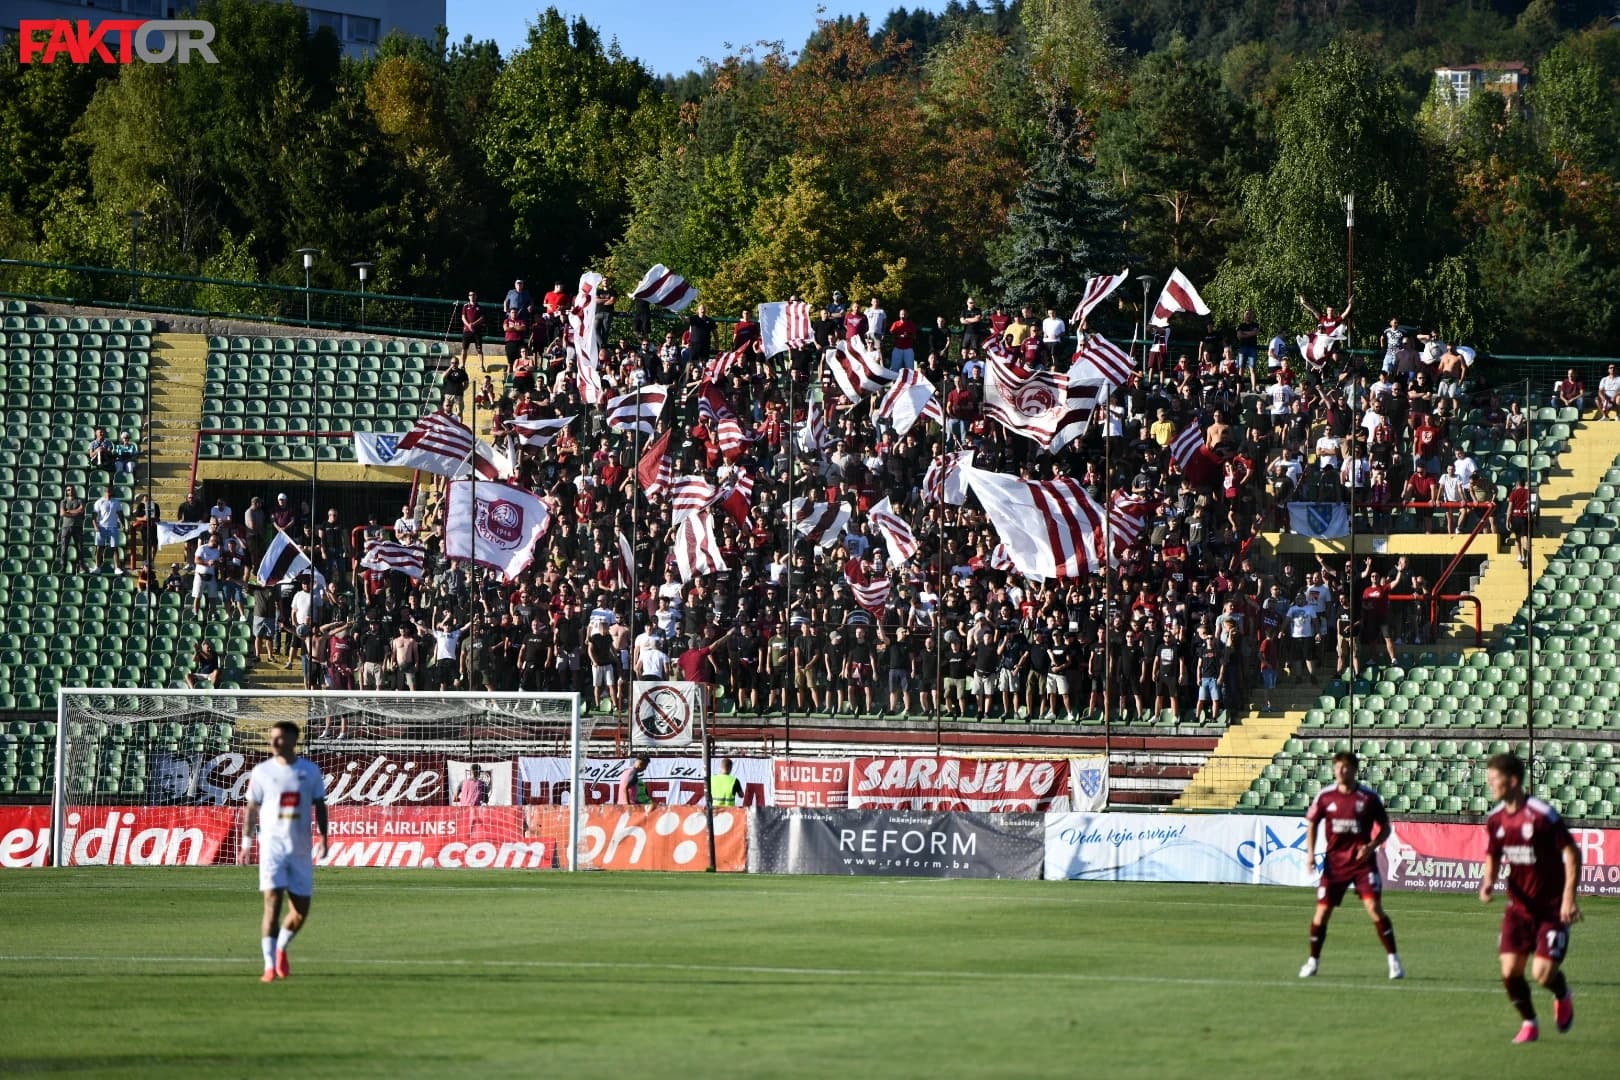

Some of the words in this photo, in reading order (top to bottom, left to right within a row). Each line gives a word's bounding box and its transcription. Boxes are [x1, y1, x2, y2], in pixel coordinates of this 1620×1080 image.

[780, 766, 843, 783] NUCLEO
[858, 758, 1055, 796] SARAJEVO
[795, 790, 826, 807] DEL
[383, 821, 457, 835] AIRLINES
[1060, 828, 1102, 846] Voda
[1106, 828, 1134, 847] koja
[1138, 825, 1187, 845] osvaja!
[840, 829, 976, 856] REFORM
[843, 858, 969, 869] www.reform.ba
[1404, 858, 1465, 879] ZAŠTITA
[1404, 879, 1427, 888] mob.
